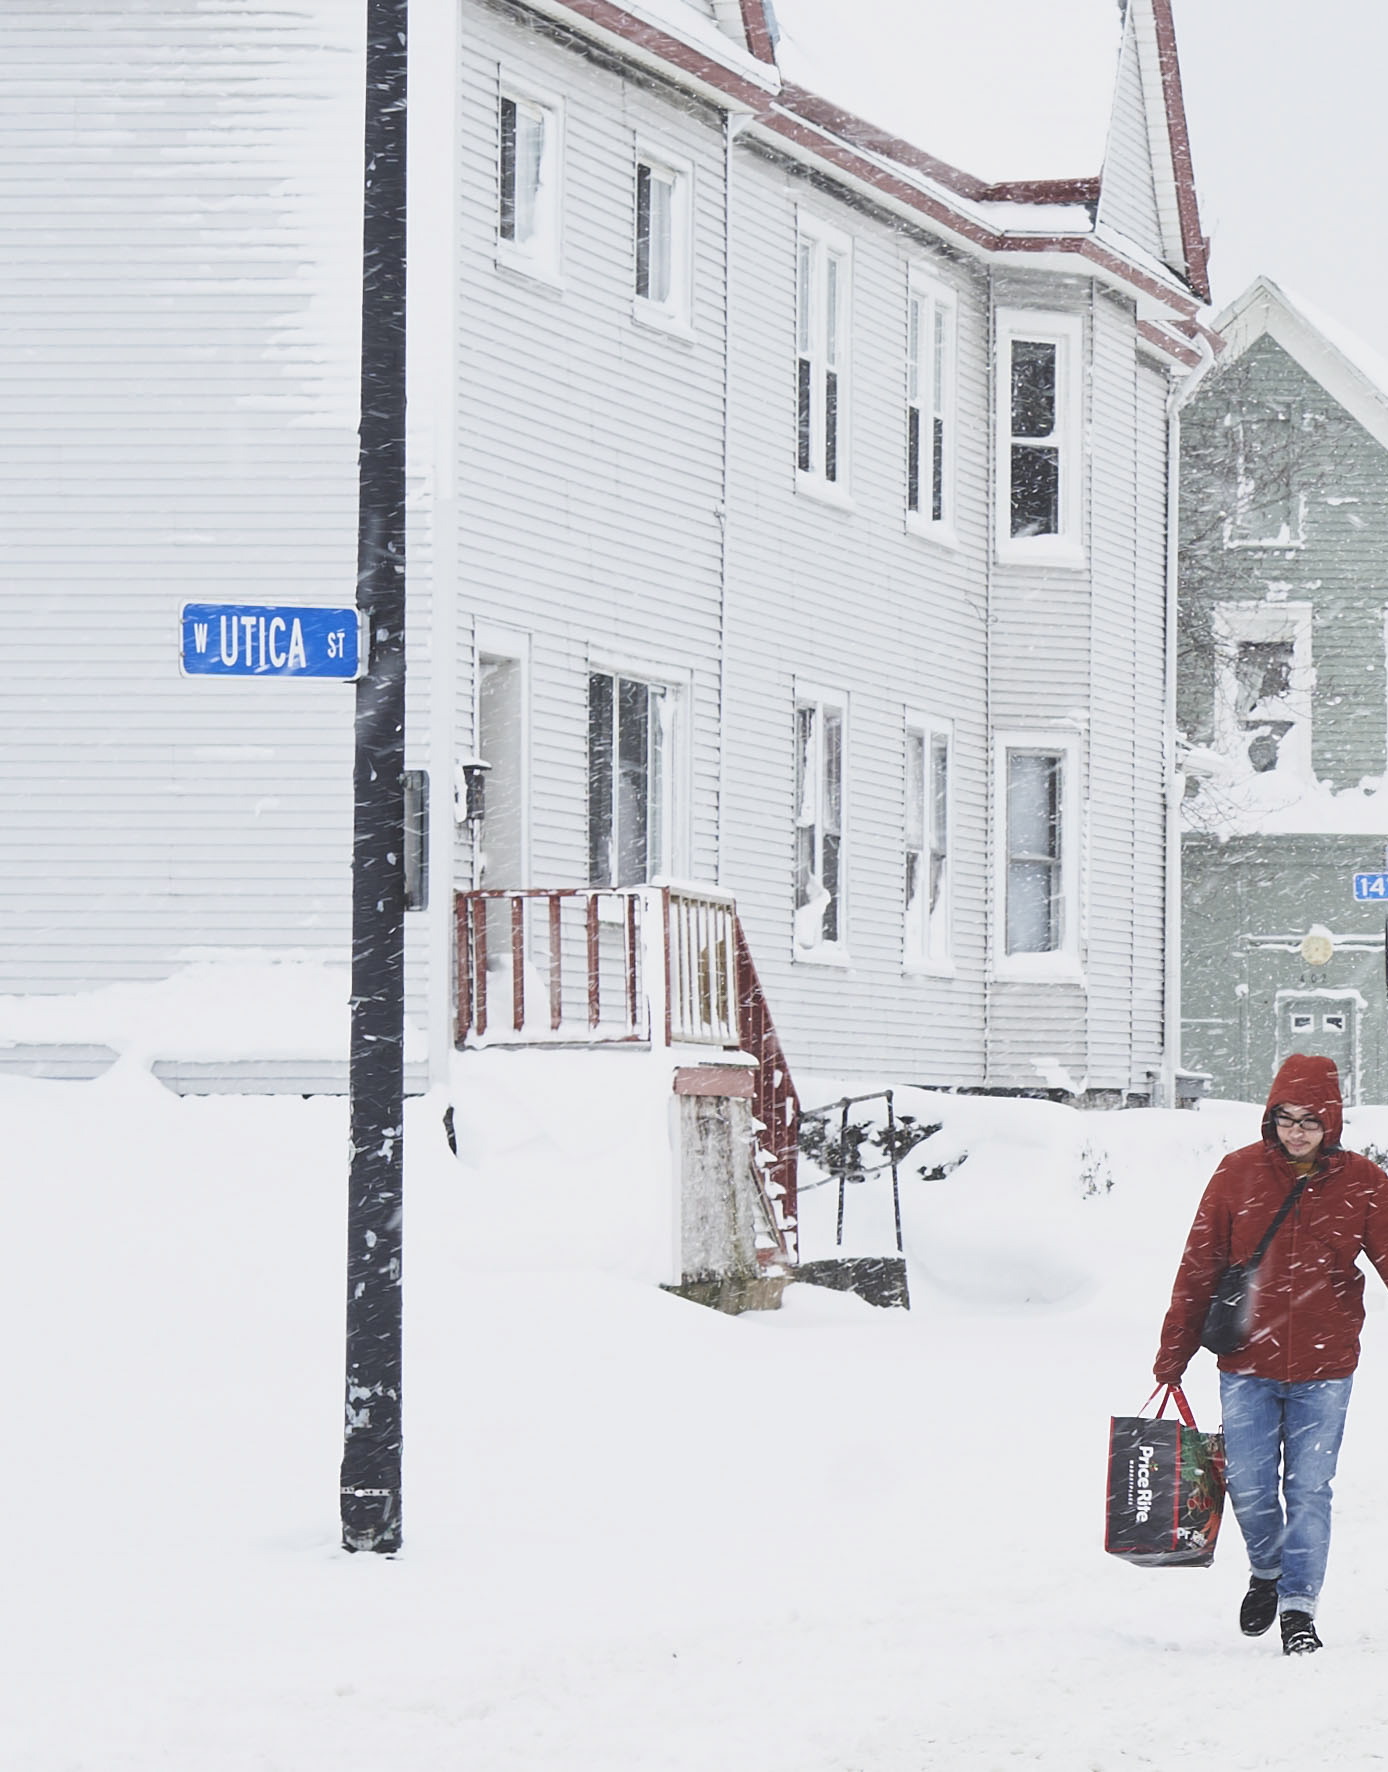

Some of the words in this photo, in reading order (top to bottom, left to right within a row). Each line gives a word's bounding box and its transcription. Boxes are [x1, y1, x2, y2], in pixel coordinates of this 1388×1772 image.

[194, 623, 208, 653] W
[220, 615, 307, 668] UTICA
[327, 632, 346, 658] ST
